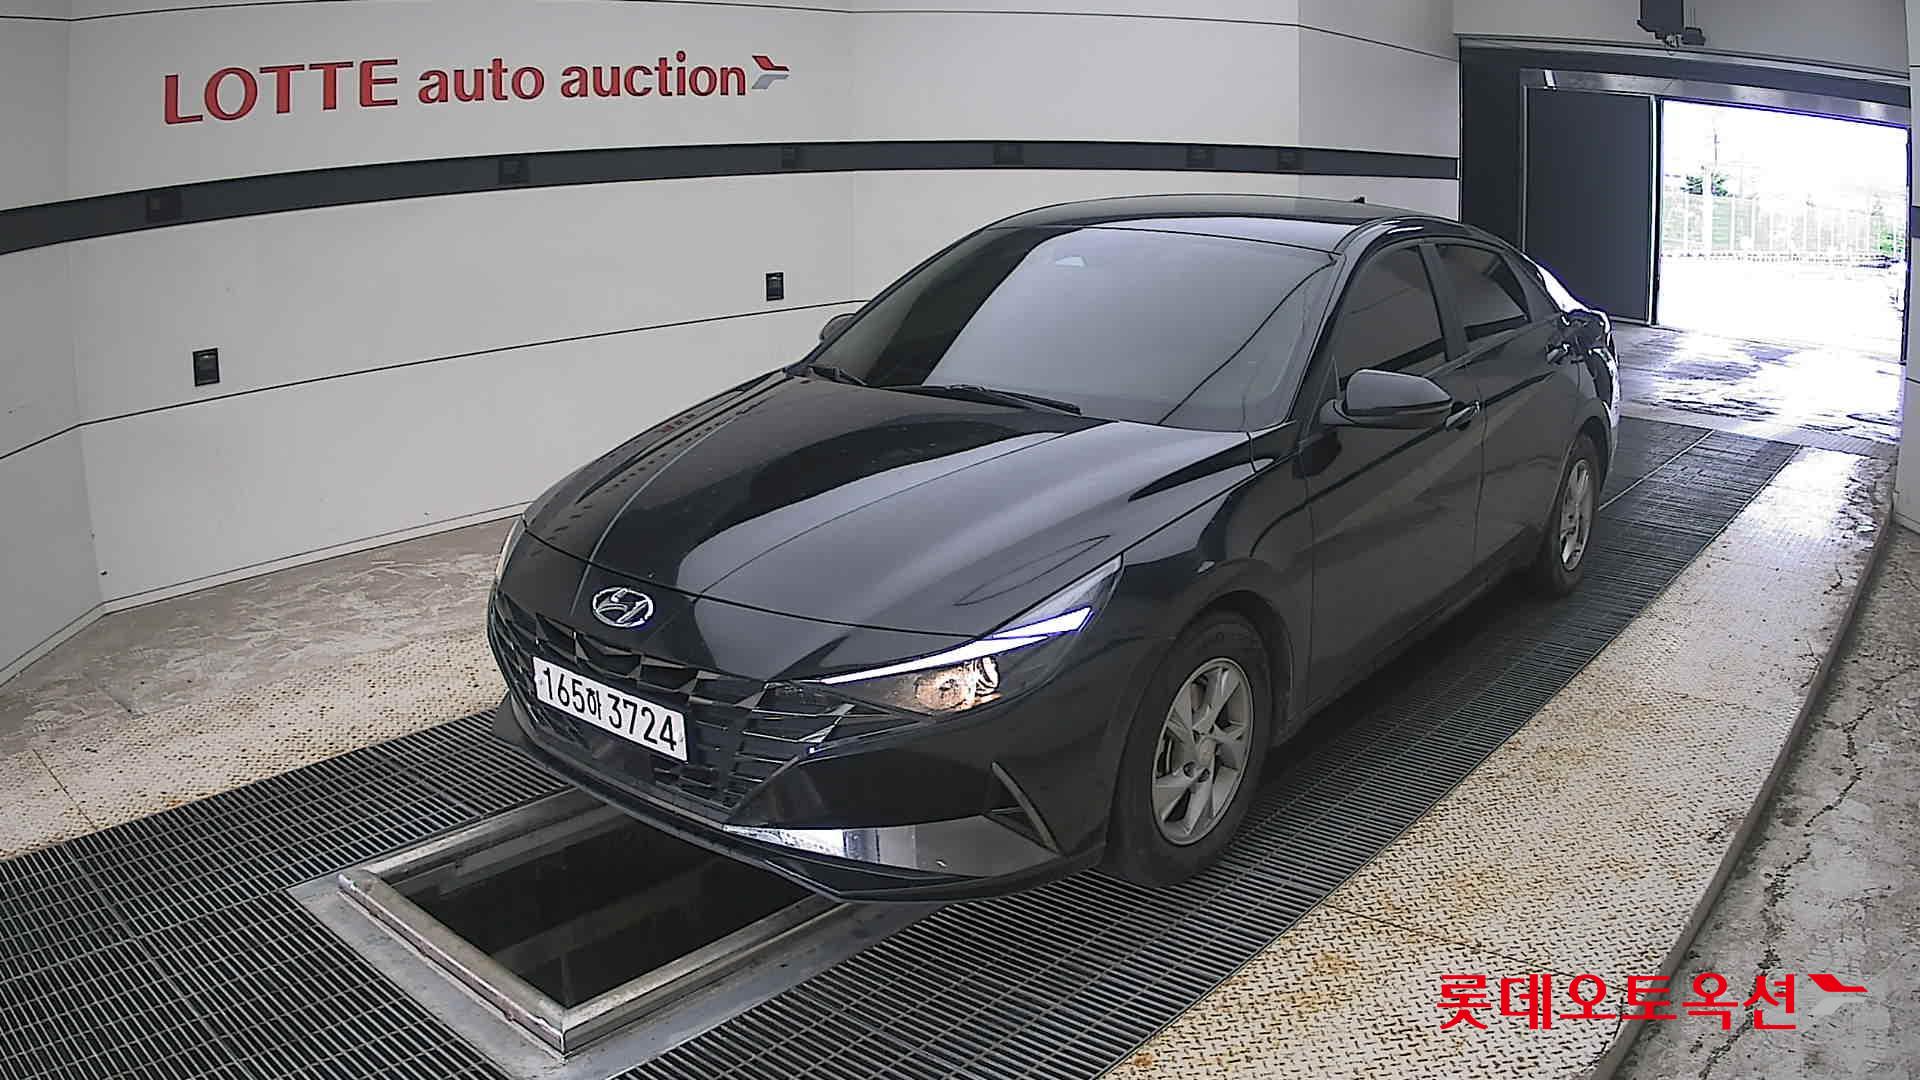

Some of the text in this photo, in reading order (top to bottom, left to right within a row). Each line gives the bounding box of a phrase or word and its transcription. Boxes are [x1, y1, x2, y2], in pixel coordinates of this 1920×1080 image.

[164, 50, 747, 125] LOTTE auto auction
